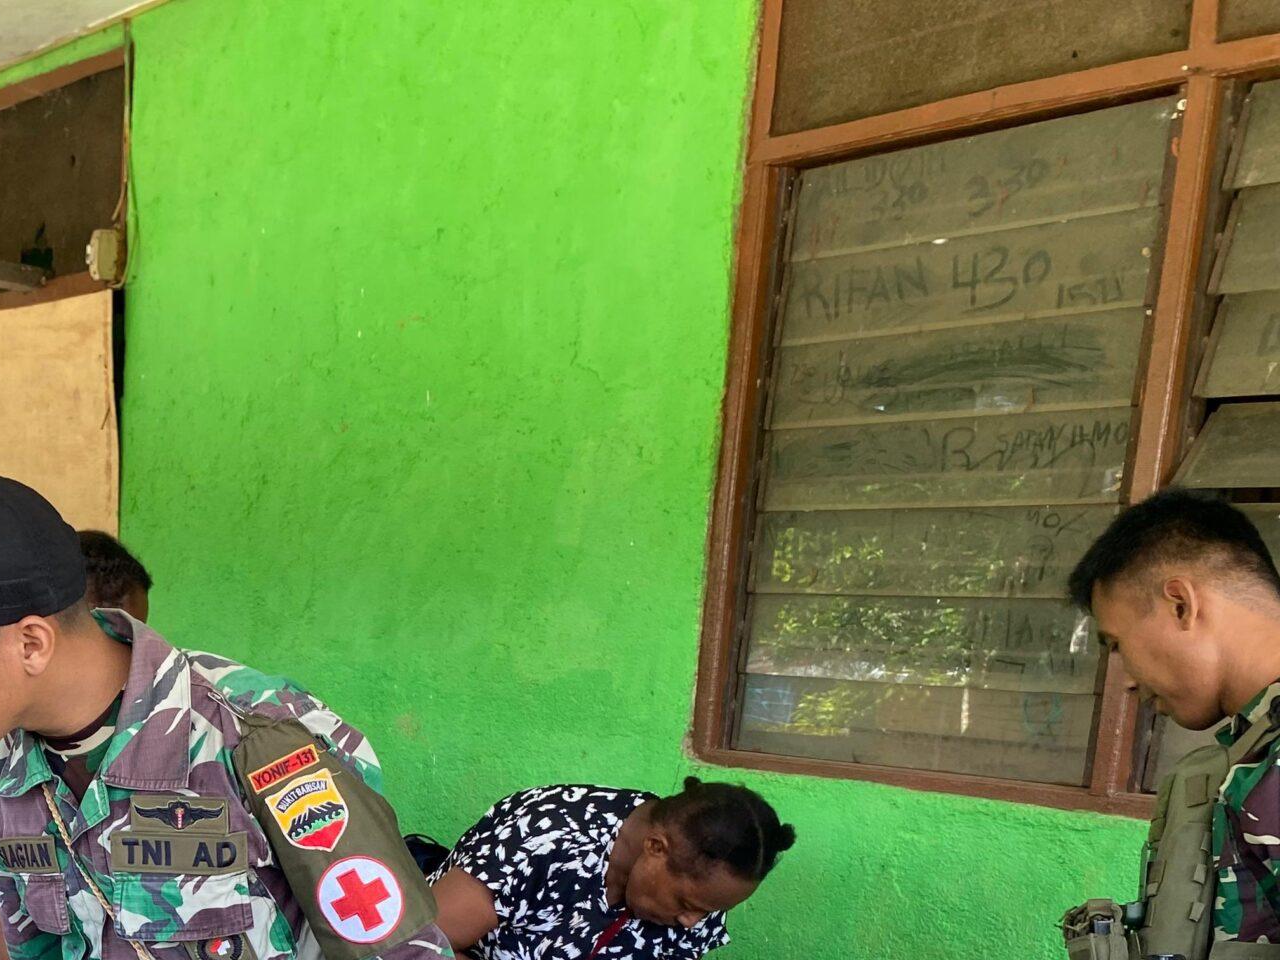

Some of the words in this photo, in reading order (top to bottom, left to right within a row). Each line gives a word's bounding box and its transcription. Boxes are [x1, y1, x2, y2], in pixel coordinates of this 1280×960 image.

[802, 258, 929, 322] RIFAN
[951, 246, 1052, 313] 430
[252, 748, 316, 789] YONIF-131
[278, 789, 299, 811] BUKIT
[295, 780, 327, 797] BARISAN
[122, 839, 172, 867] TNI
[192, 841, 237, 868] AD
